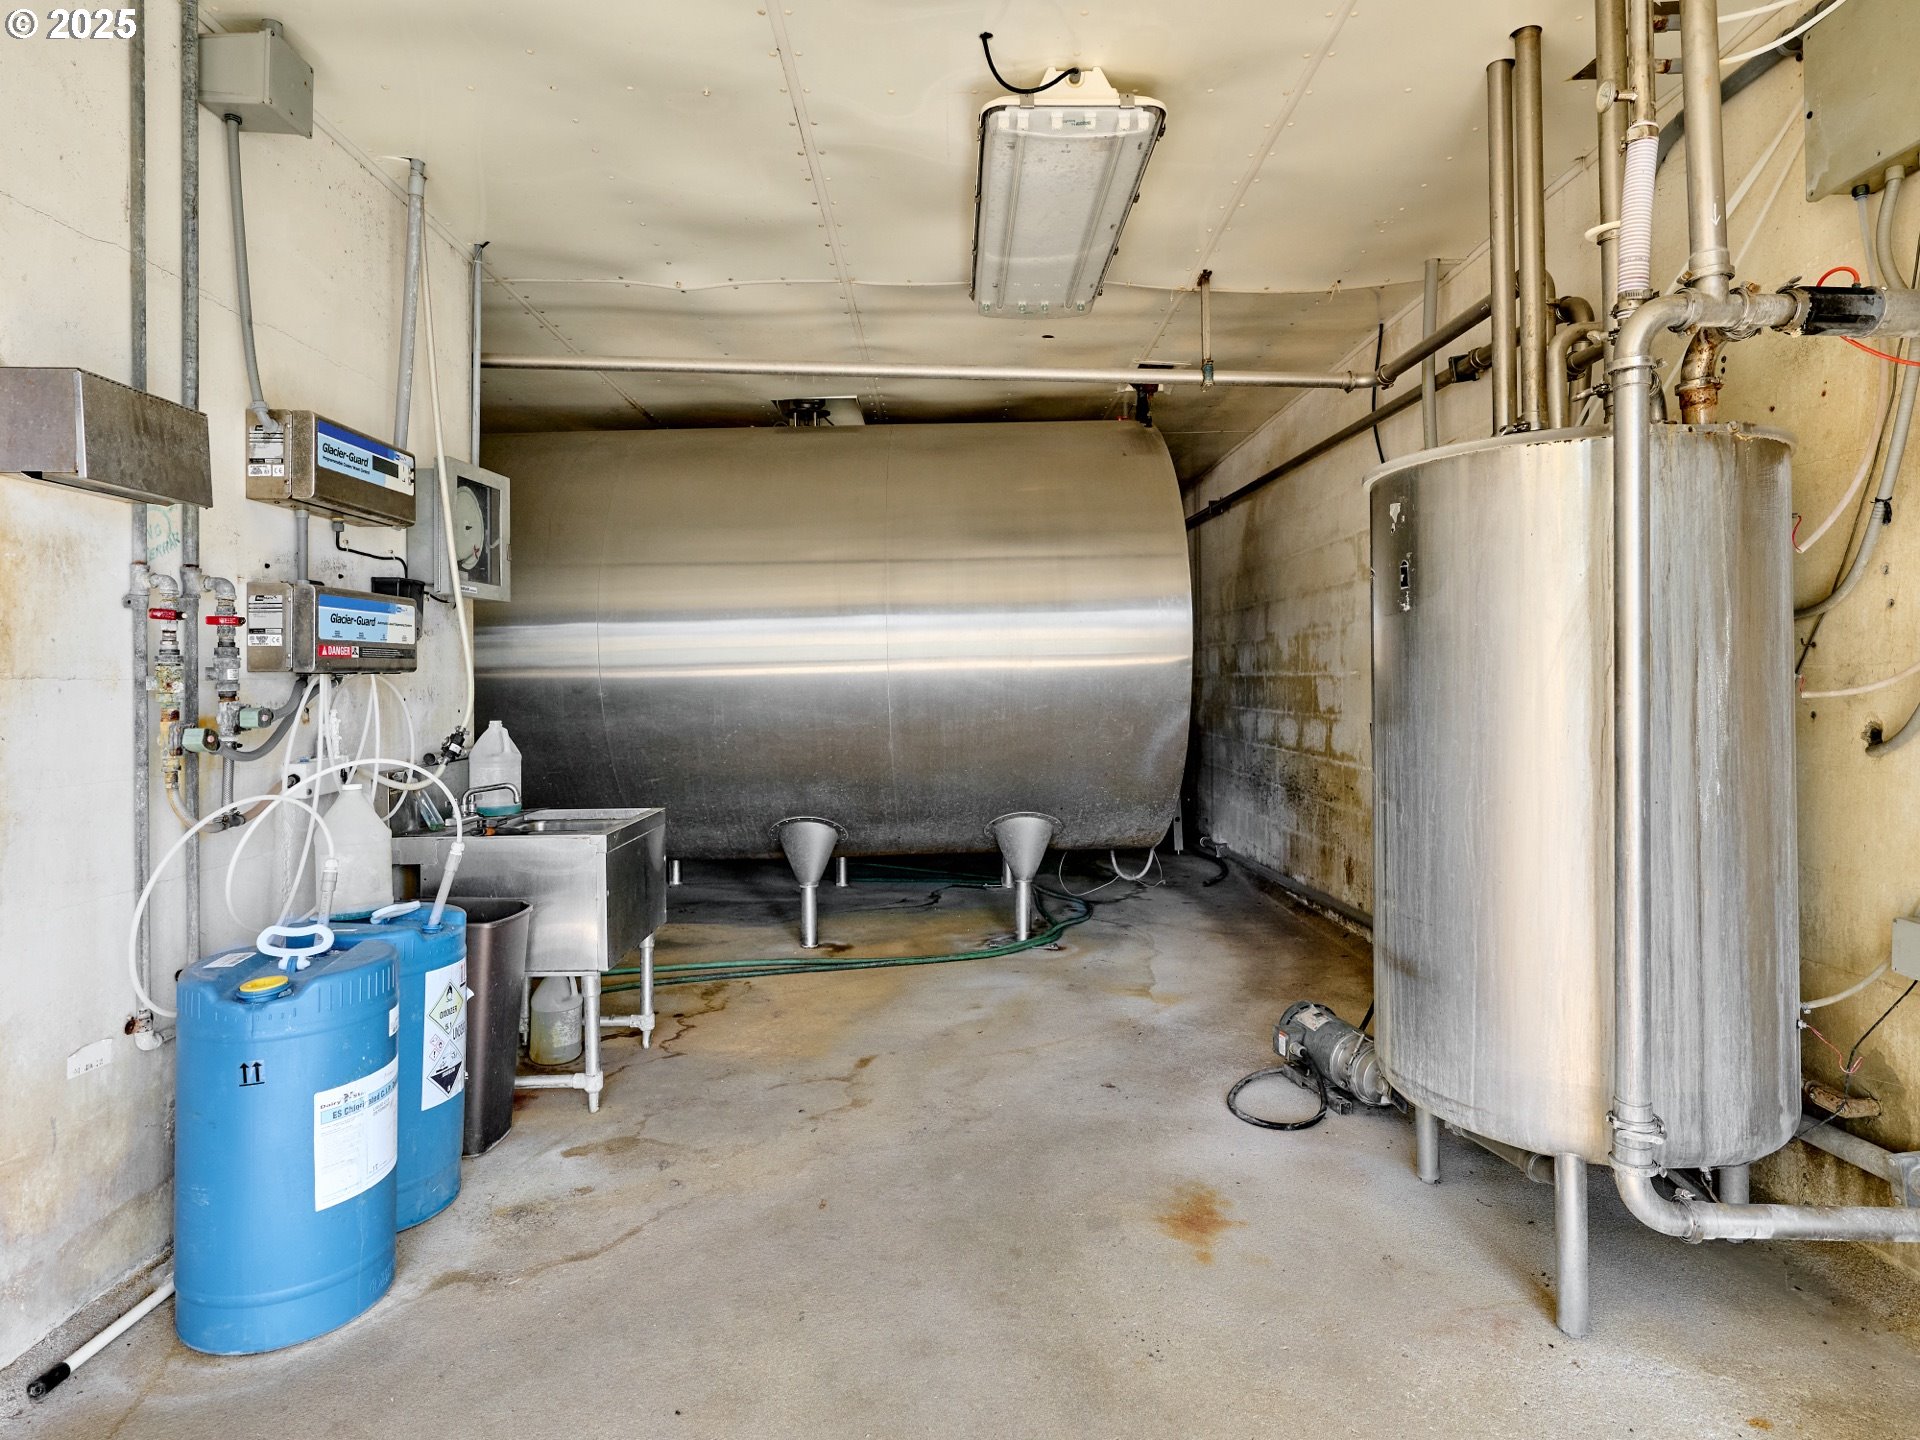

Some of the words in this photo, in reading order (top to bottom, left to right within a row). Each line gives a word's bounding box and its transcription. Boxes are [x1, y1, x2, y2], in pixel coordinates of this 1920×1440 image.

[322, 442, 369, 467] Glacier-Guard
[330, 612, 376, 627] Glacier-Guard
[327, 645, 351, 656] DANGER
[319, 1100, 342, 1110] Dairy
[332, 1109, 343, 1120] ES
